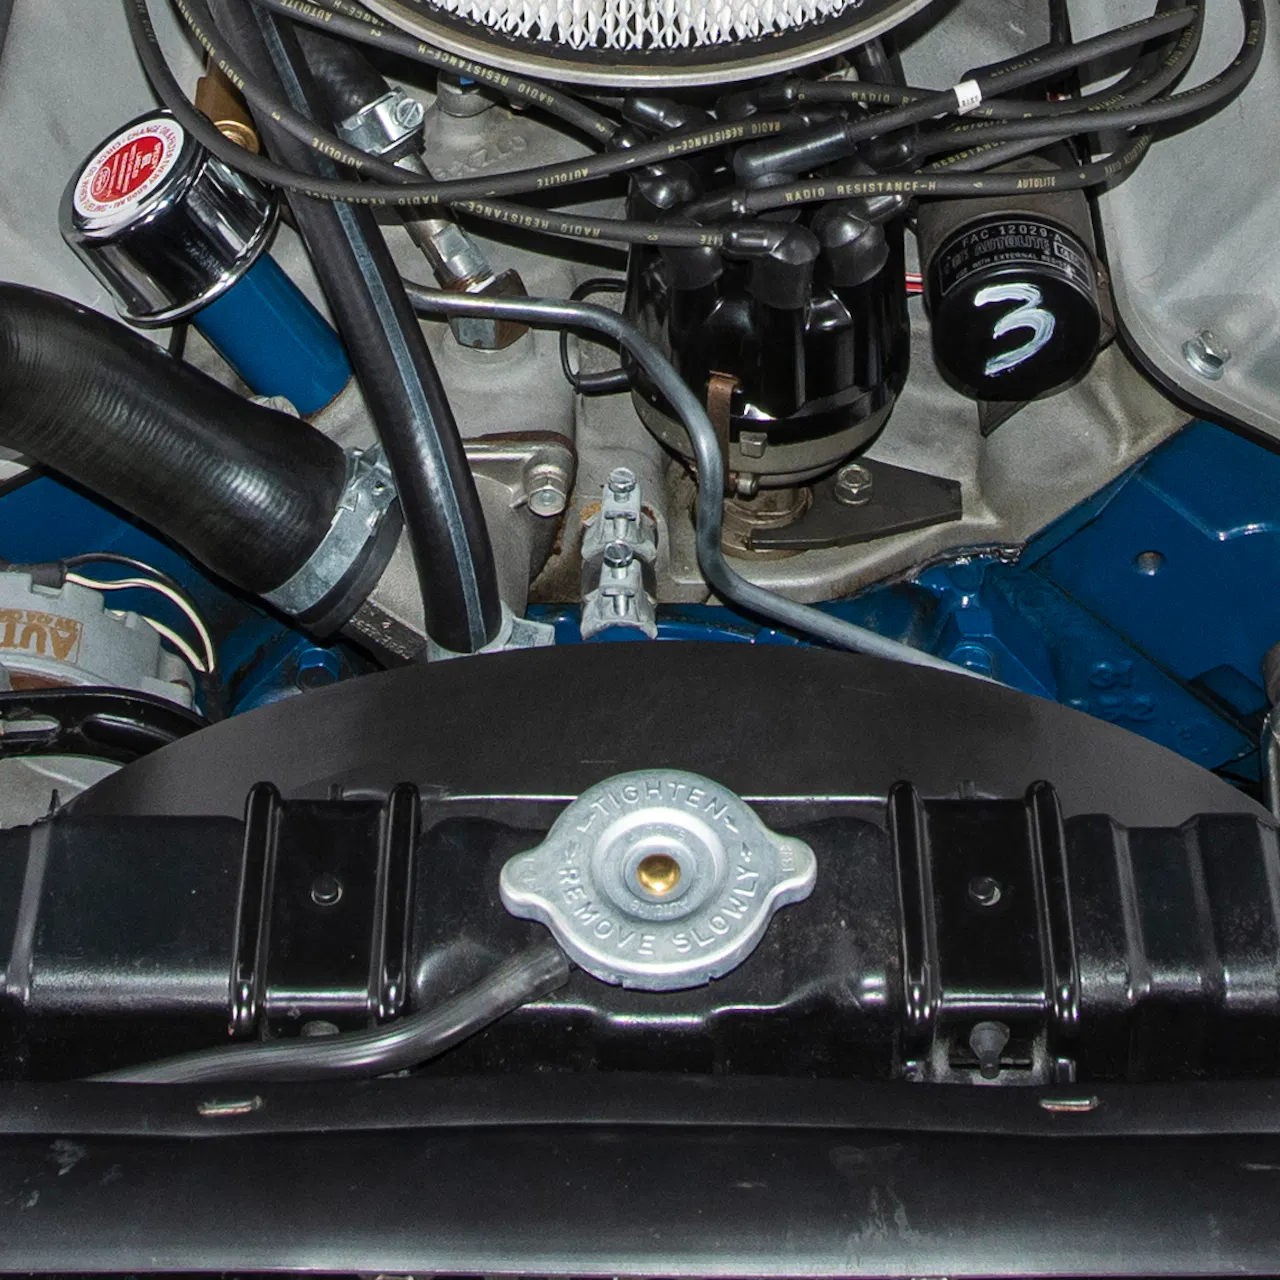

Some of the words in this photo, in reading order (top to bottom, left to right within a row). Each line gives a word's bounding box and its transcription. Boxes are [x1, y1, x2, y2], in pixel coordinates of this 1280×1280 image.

[219, 59, 245, 90] RADIO
[419, 44, 509, 86] RESISTANCE-H
[518, 82, 555, 105] RADIO
[851, 92, 890, 103] RADIO
[668, 126, 744, 153] RESISTANCE-H
[751, 122, 781, 134] RADIO
[312, 137, 363, 170] AUTOLITE
[536, 168, 589, 188] AUTOLITE
[785, 188, 825, 202] RADIO
[837, 179, 937, 195] RESISTANCE-H
[1017, 176, 1056, 189] AUTOLITE
[560, 222, 600, 237] RADIO
[974, 235, 1051, 256] AUTOLITE
[994, 252, 1038, 262] EXTERNAL
[974, 282, 1056, 376] 3
[590, 780, 730, 819] TIGHTEN
[558, 868, 656, 955] REMOVE
[671, 870, 760, 954] SLOWLY
